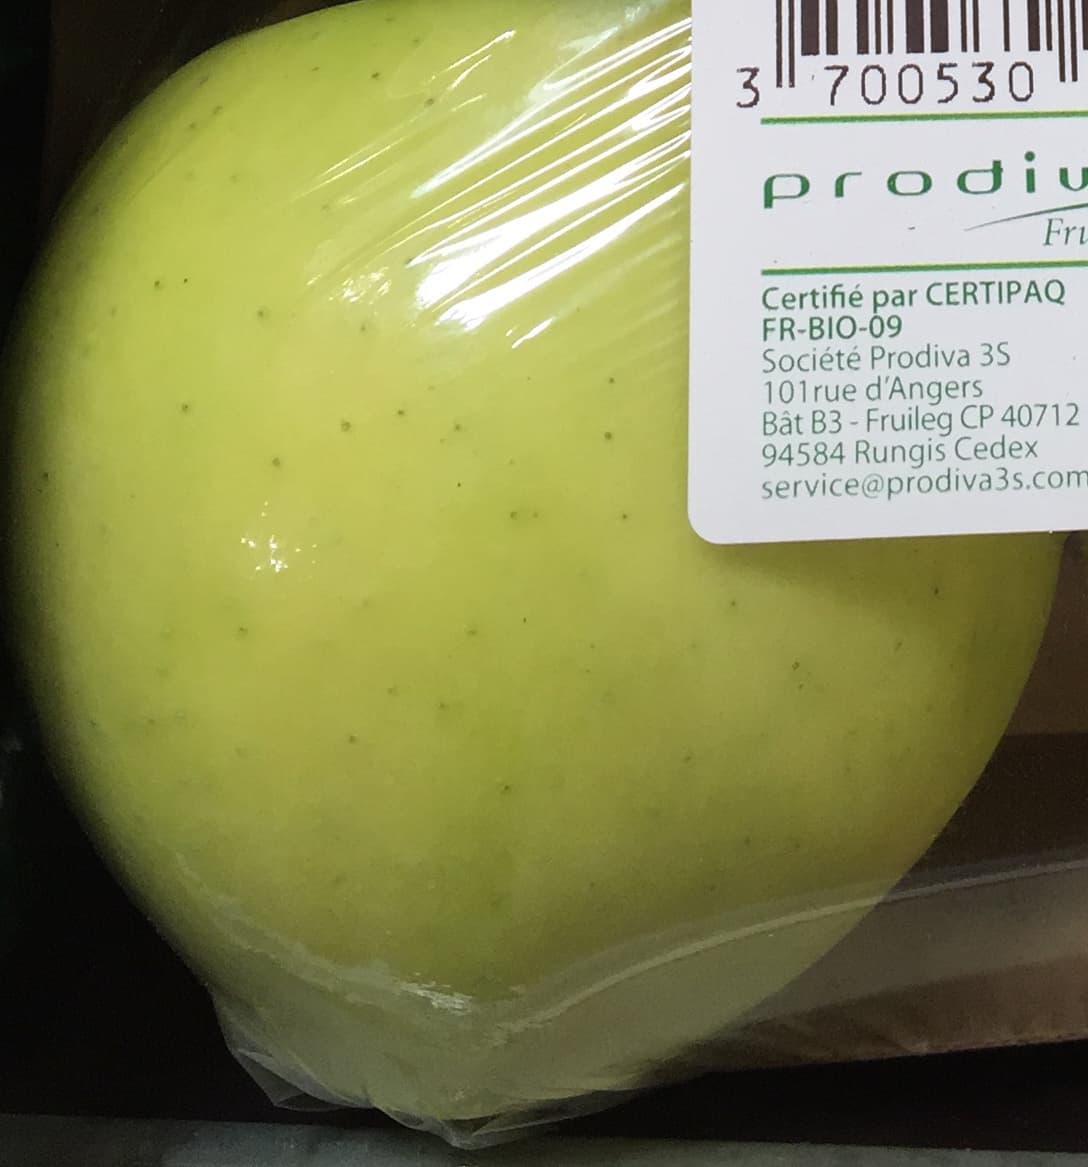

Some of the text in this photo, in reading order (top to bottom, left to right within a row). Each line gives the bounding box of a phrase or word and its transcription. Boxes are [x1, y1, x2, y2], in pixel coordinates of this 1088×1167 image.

[736, 67, 760, 108] 3
[824, 61, 1034, 106] 700530
[762, 279, 1065, 314] Certifié par CERTIPAQ
[763, 315, 902, 342] FR-BIO-09
[763, 342, 1010, 373] Société Prodiva 3S
[866, 376, 983, 406] d'Angers
[763, 411, 803, 436] Bât
[812, 410, 842, 434] B3
[867, 406, 952, 437] Fruileg
[961, 405, 993, 429] CP
[1001, 403, 1079, 427] 40712
[762, 434, 1037, 469] 94584 Rungis Cedex
